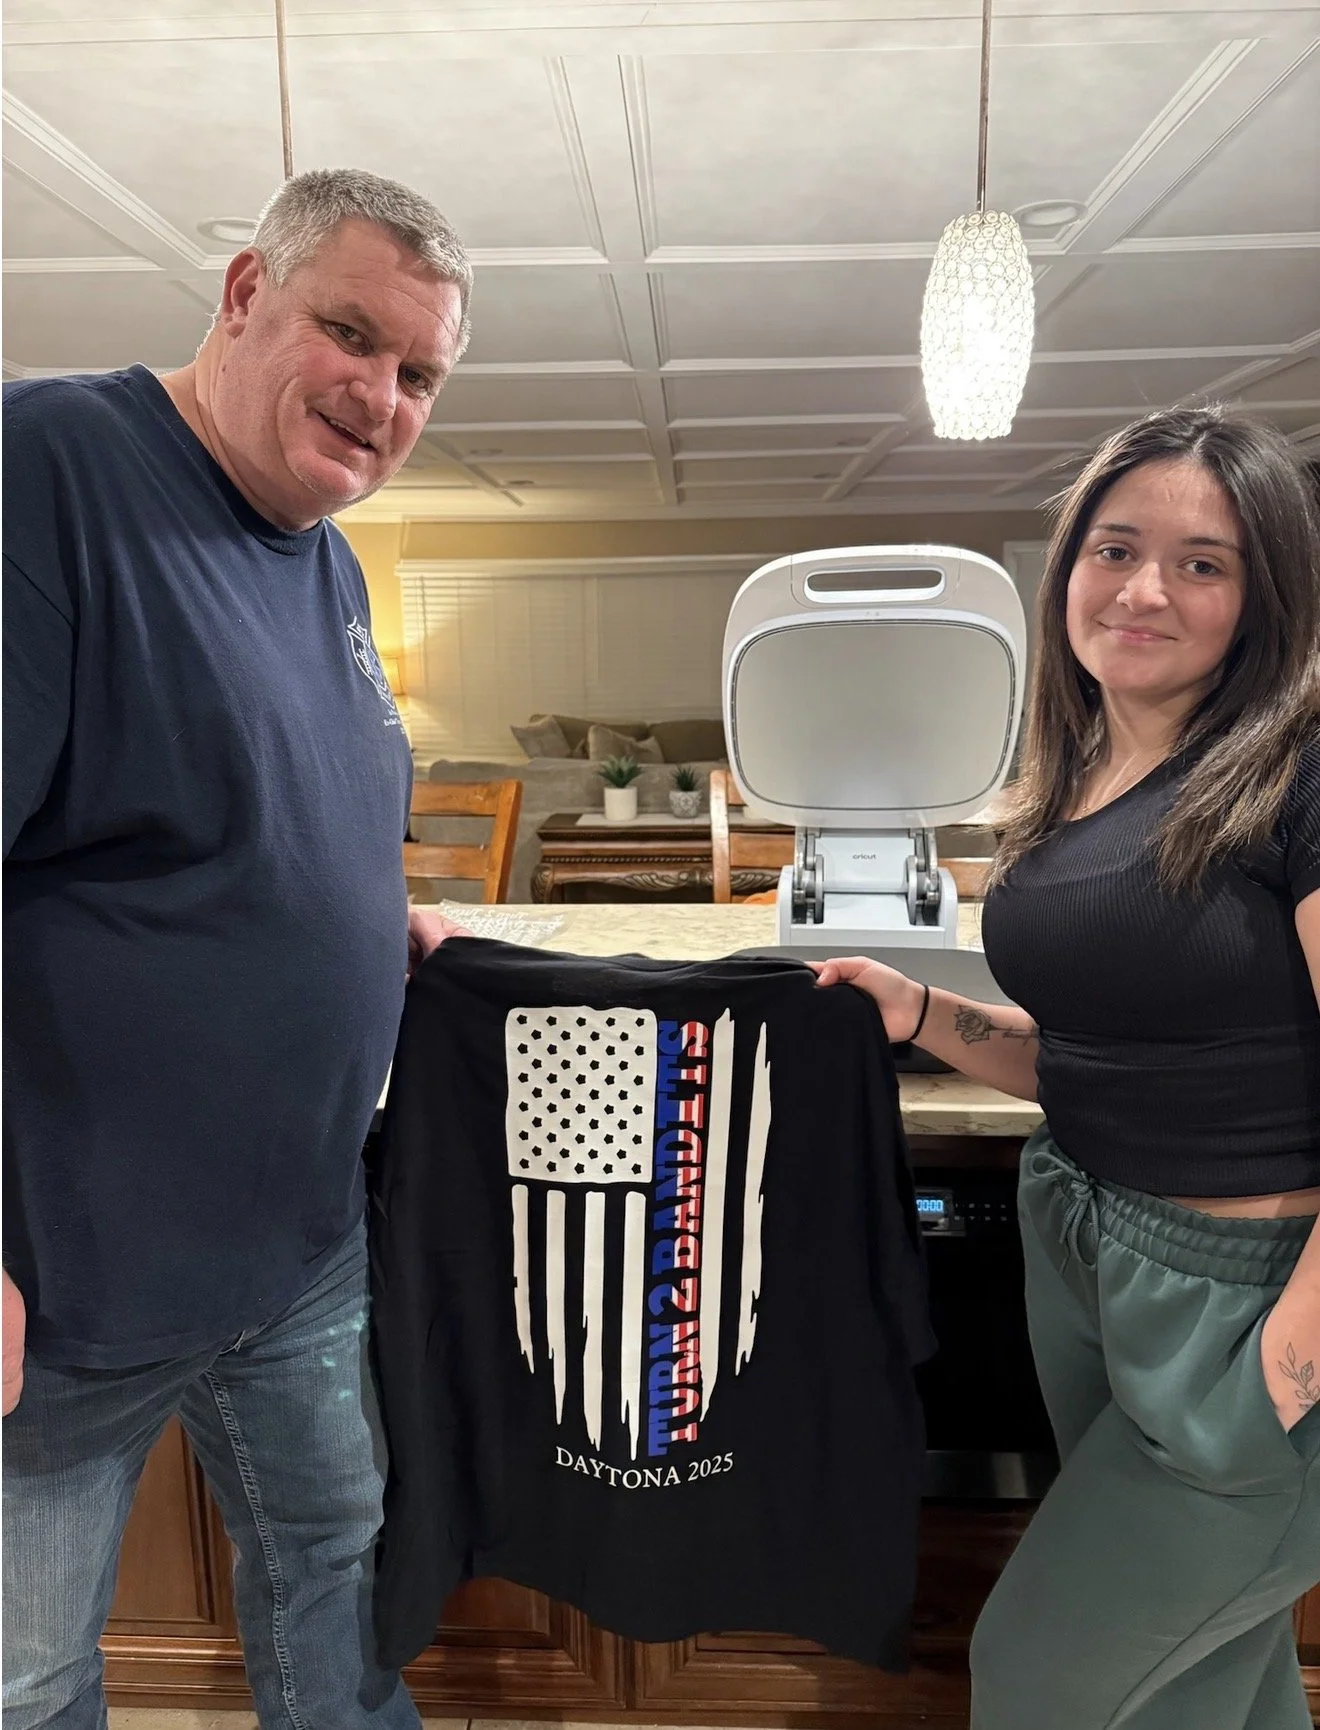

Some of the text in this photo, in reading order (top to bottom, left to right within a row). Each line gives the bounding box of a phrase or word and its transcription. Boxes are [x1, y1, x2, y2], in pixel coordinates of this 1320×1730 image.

[647, 1020, 709, 1456] TURN 2 BANDITS
[555, 1445, 735, 1490] DAYTONA 2025
